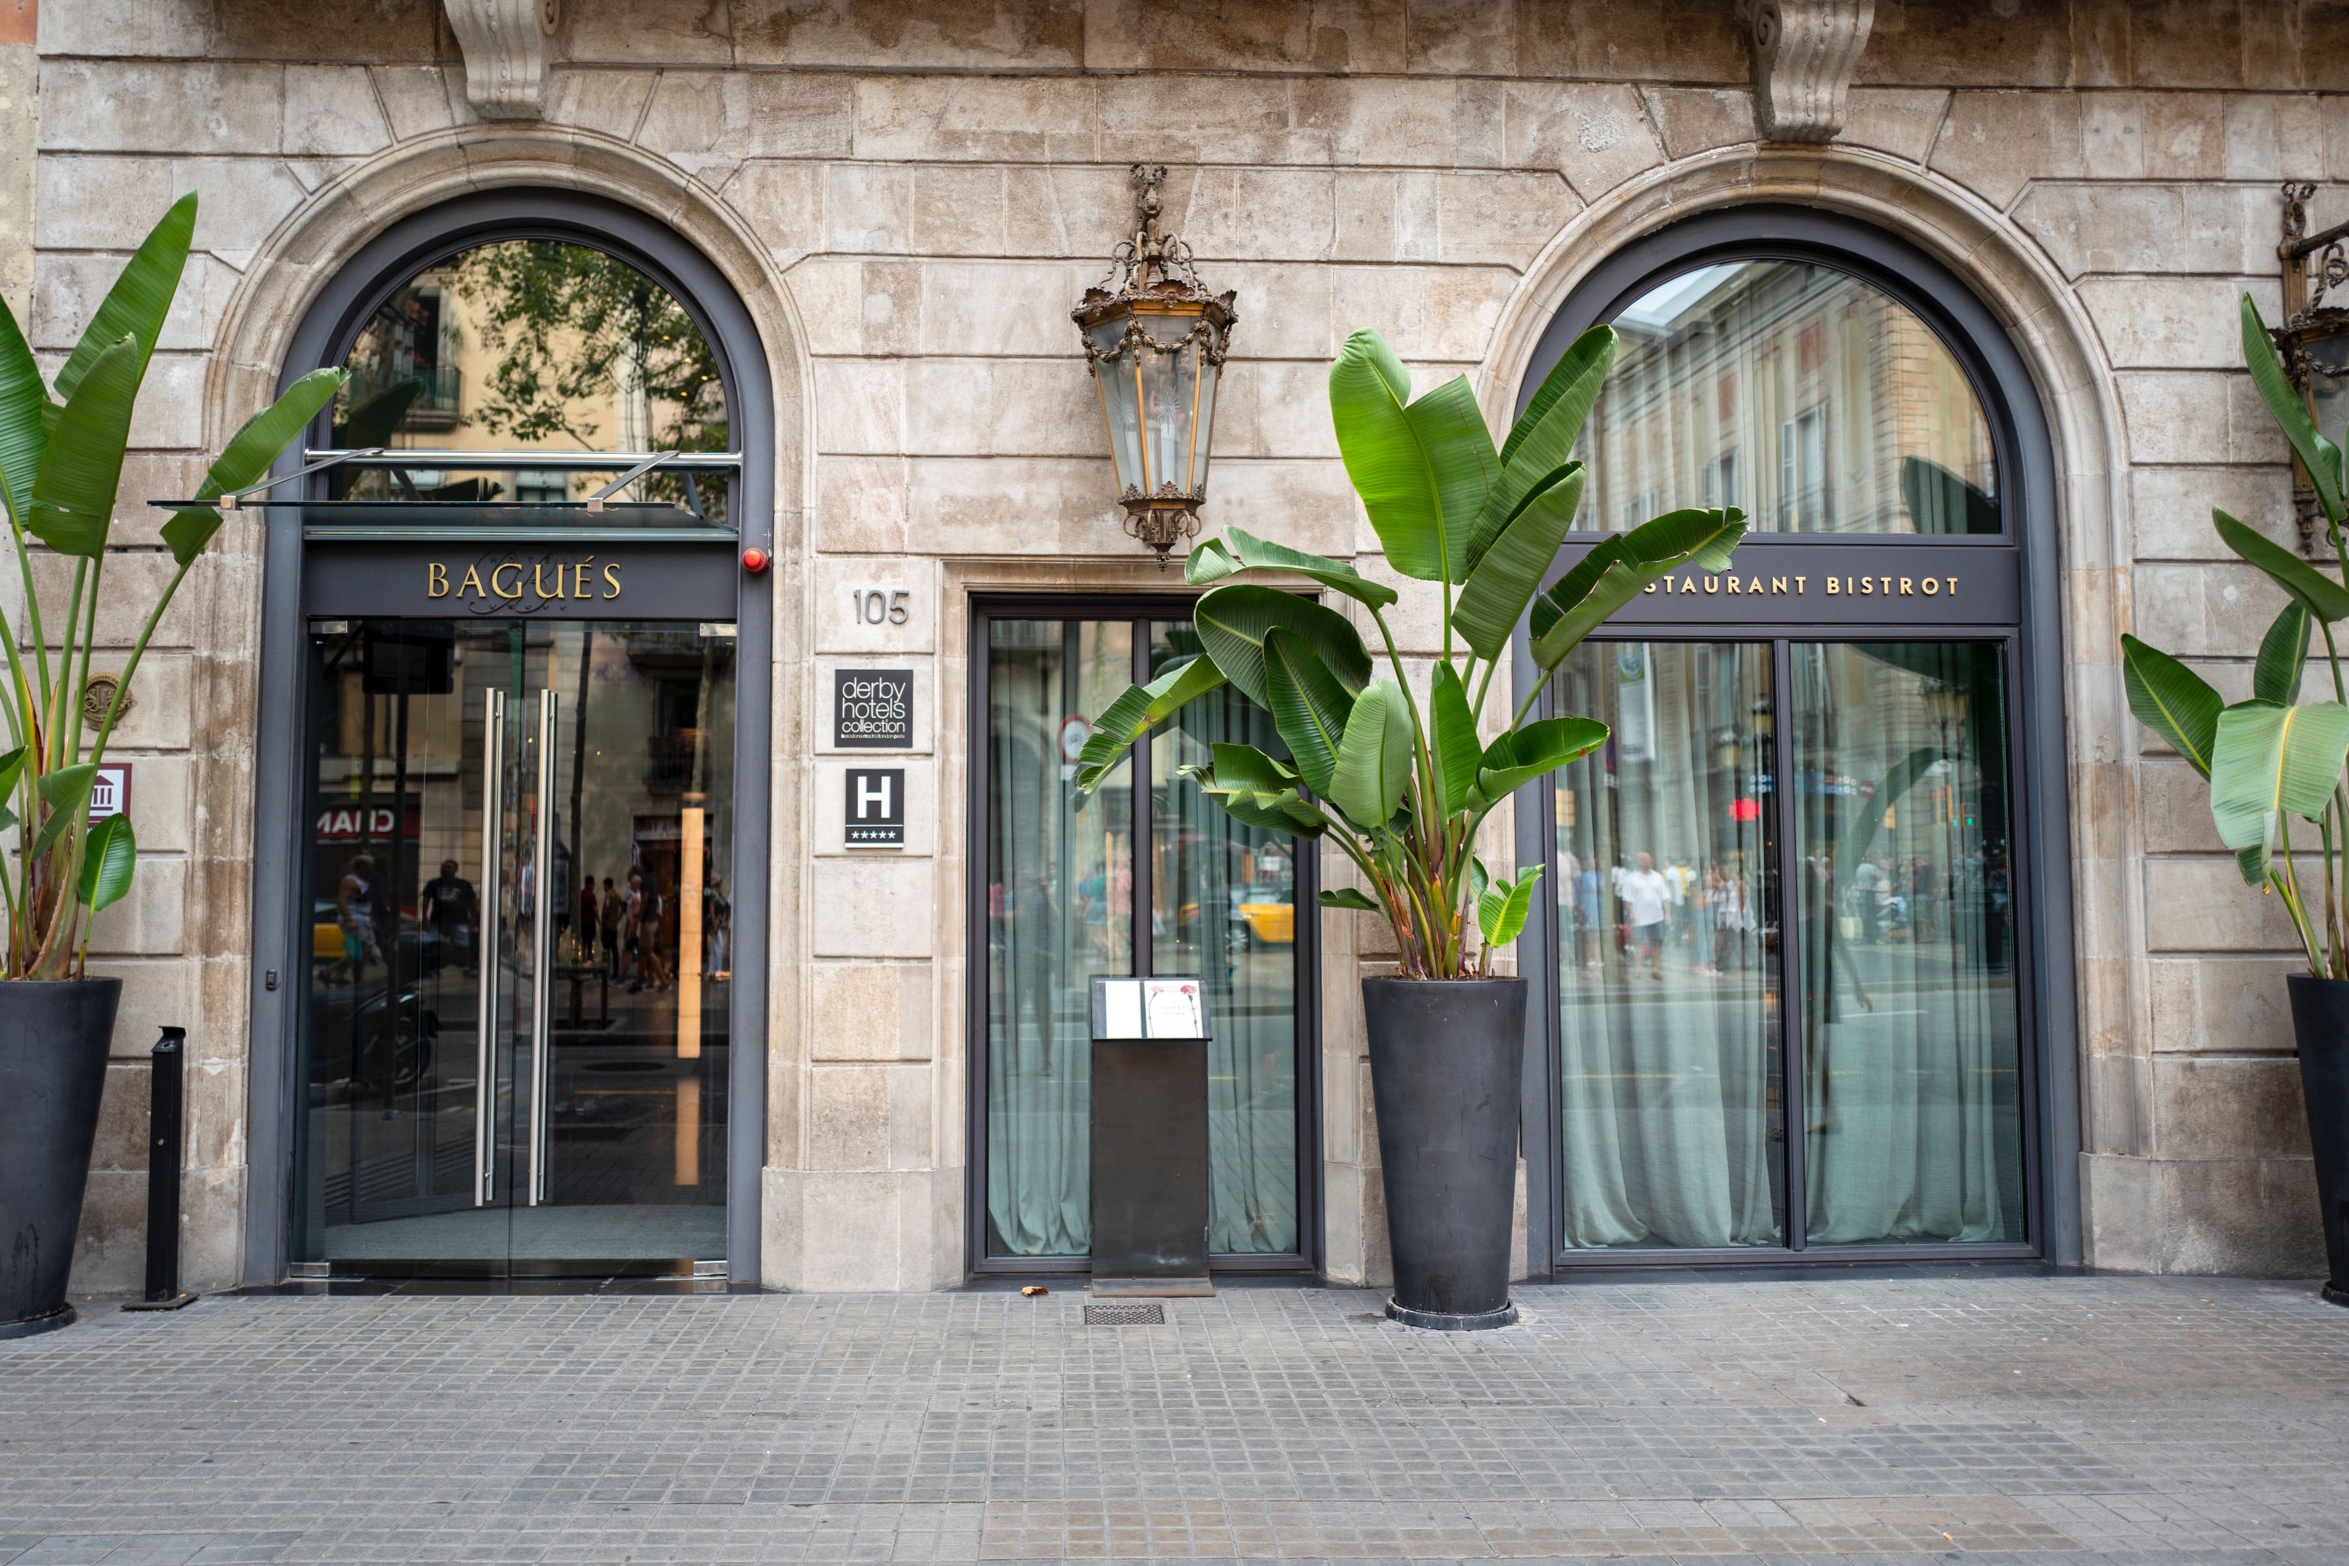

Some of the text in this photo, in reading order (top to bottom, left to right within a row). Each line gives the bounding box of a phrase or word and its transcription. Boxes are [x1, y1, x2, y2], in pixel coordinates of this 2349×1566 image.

[427, 555, 621, 599] BAGUÉS
[1827, 576, 1959, 596] BISTROT
[853, 589, 910, 624] 105
[842, 677, 906, 703] derby
[842, 697, 906, 719] hotels
[841, 719, 906, 733] collection
[857, 776, 891, 818] H
